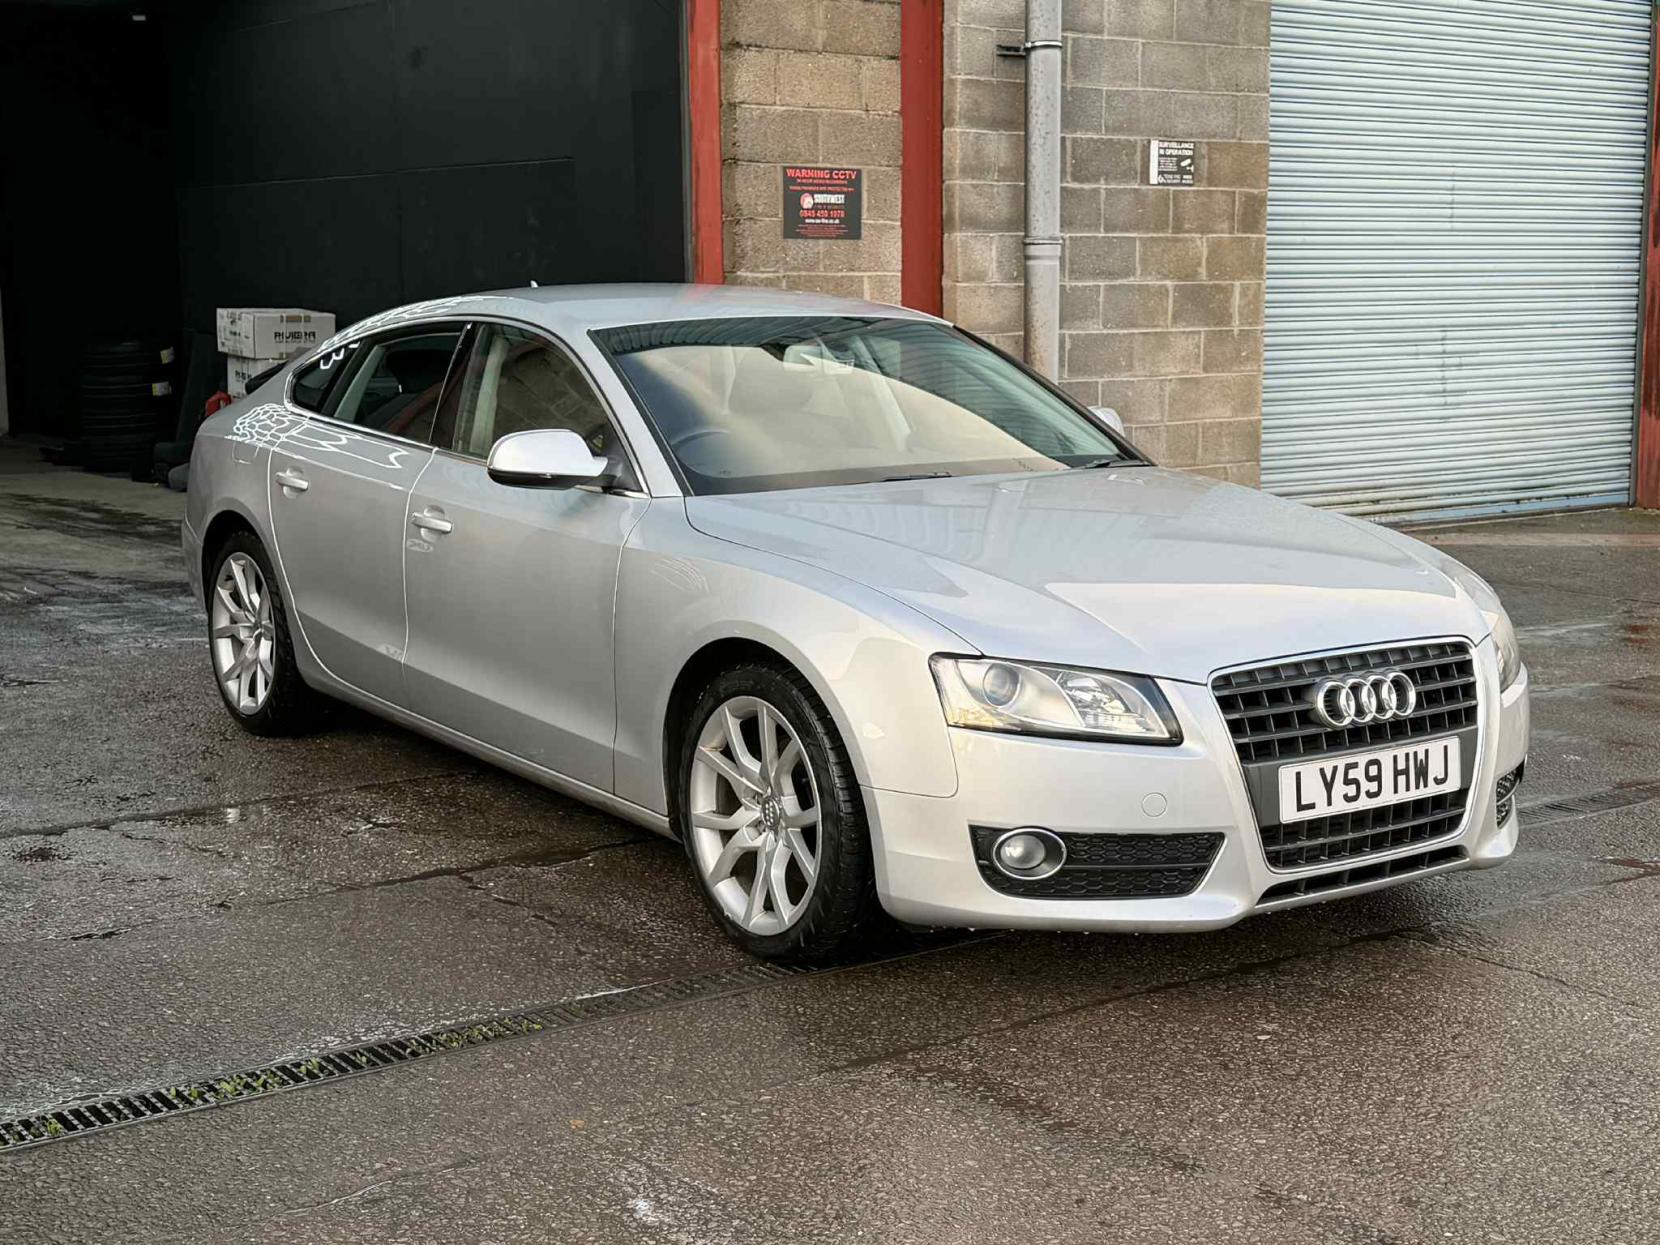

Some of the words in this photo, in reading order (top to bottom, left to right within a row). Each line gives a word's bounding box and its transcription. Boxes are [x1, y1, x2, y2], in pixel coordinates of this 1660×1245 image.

[786, 168, 830, 178] WARNING
[832, 170, 857, 179] CCTV
[1295, 758, 1382, 812] LY59
[1393, 745, 1449, 794] HWJ
